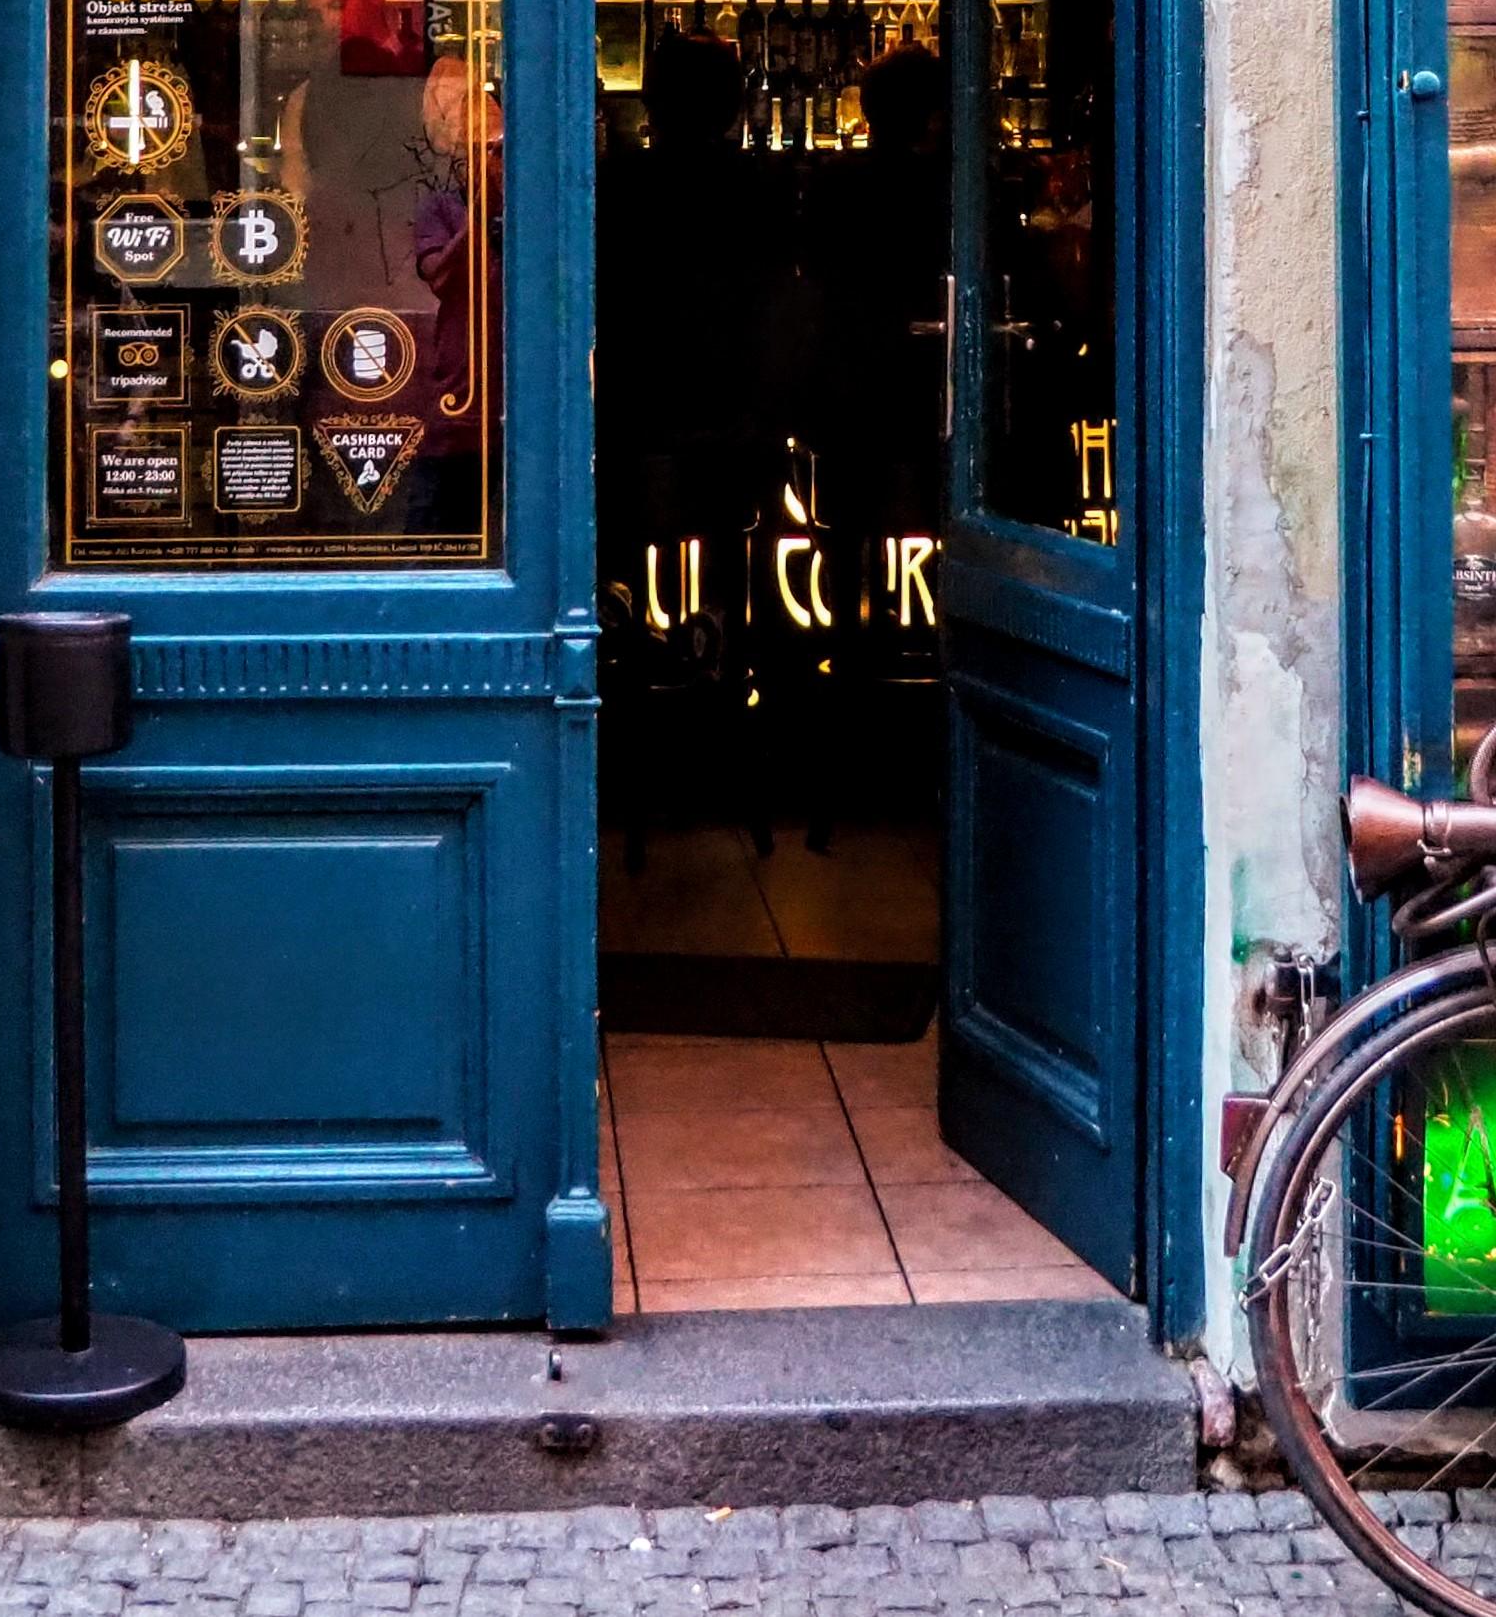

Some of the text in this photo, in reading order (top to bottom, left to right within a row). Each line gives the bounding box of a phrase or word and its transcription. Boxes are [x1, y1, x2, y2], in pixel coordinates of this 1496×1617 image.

[86, 0, 136, 16] Objekt
[125, 212, 154, 223] Free
[124, 250, 155, 263] Spot
[104, 327, 173, 338] Recommended
[111, 374, 168, 388] tripadvisor
[332, 433, 403, 446] CASHBACK
[349, 446, 386, 459] CARD
[102, 454, 178, 468] We are open
[105, 470, 136, 482] 12:00
[145, 469, 176, 482] 23:00
